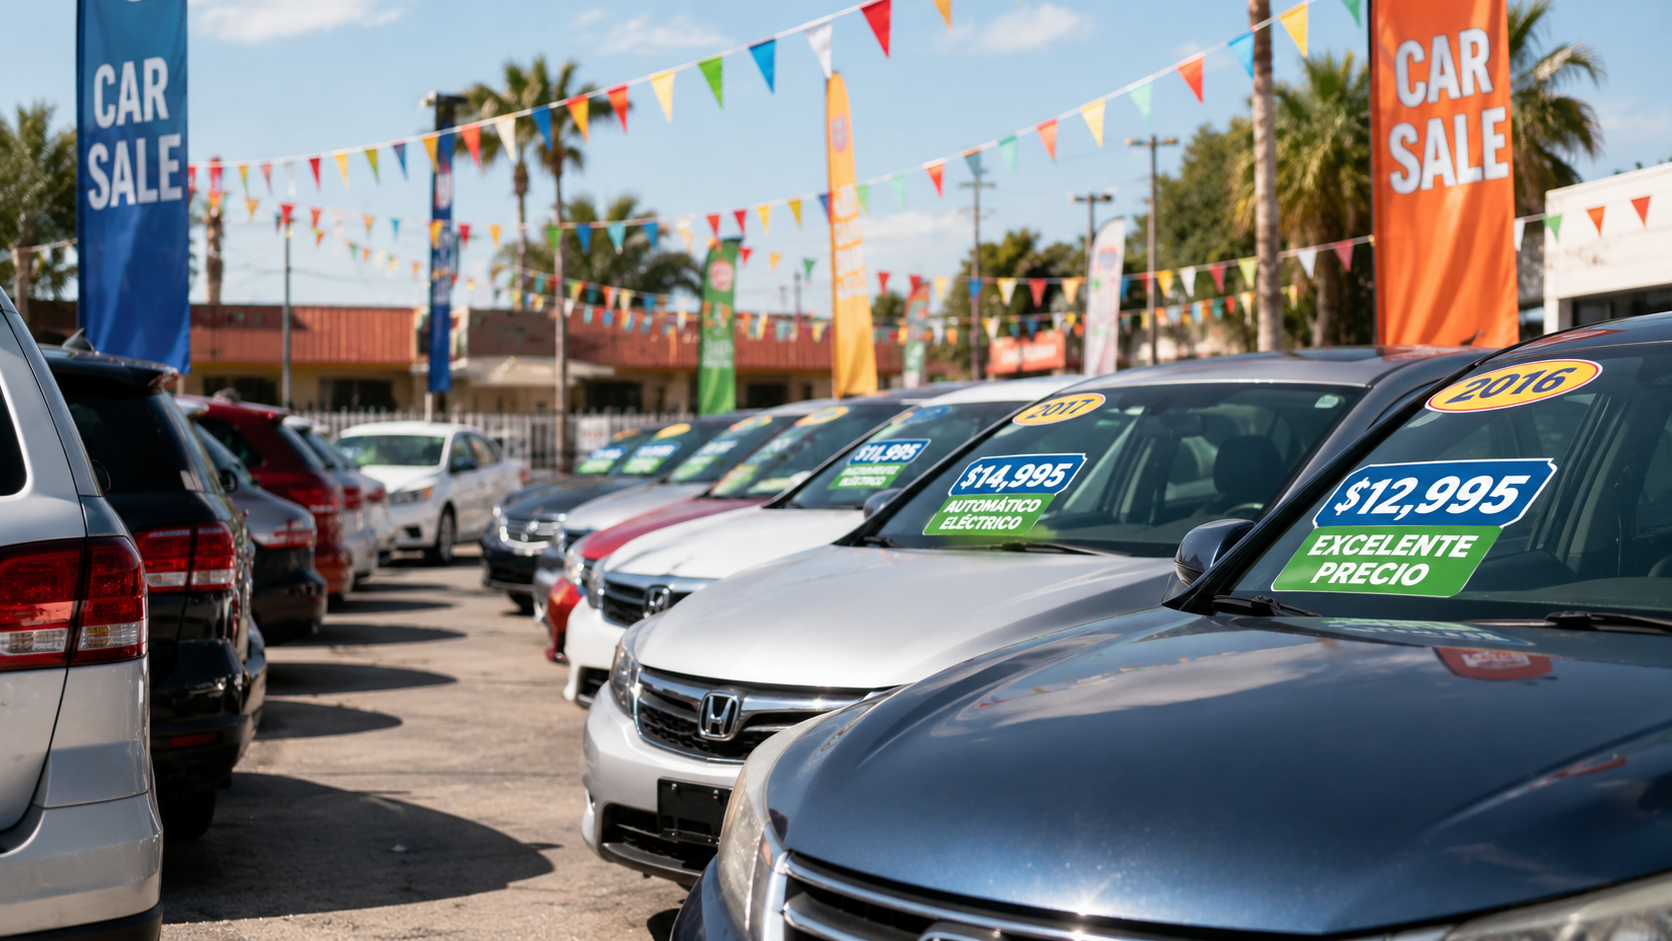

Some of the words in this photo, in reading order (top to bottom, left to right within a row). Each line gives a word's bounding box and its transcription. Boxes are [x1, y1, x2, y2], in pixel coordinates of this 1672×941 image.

[1394, 27, 1495, 109] CAR
[93, 56, 170, 129] CAR
[1388, 105, 1510, 195] SALE
[87, 133, 183, 211] SALE
[1444, 367, 1579, 406] 2016
[1024, 399, 1096, 421] 2017
[959, 463, 1074, 493] $14,995
[942, 496, 1042, 514] AUTOMÁTICO
[1333, 475, 1532, 521] $12,995
[938, 513, 1023, 531] ELÉCTRICO
[1306, 533, 1480, 558] EXCELENTE
[1309, 561, 1430, 587] PRECIO
